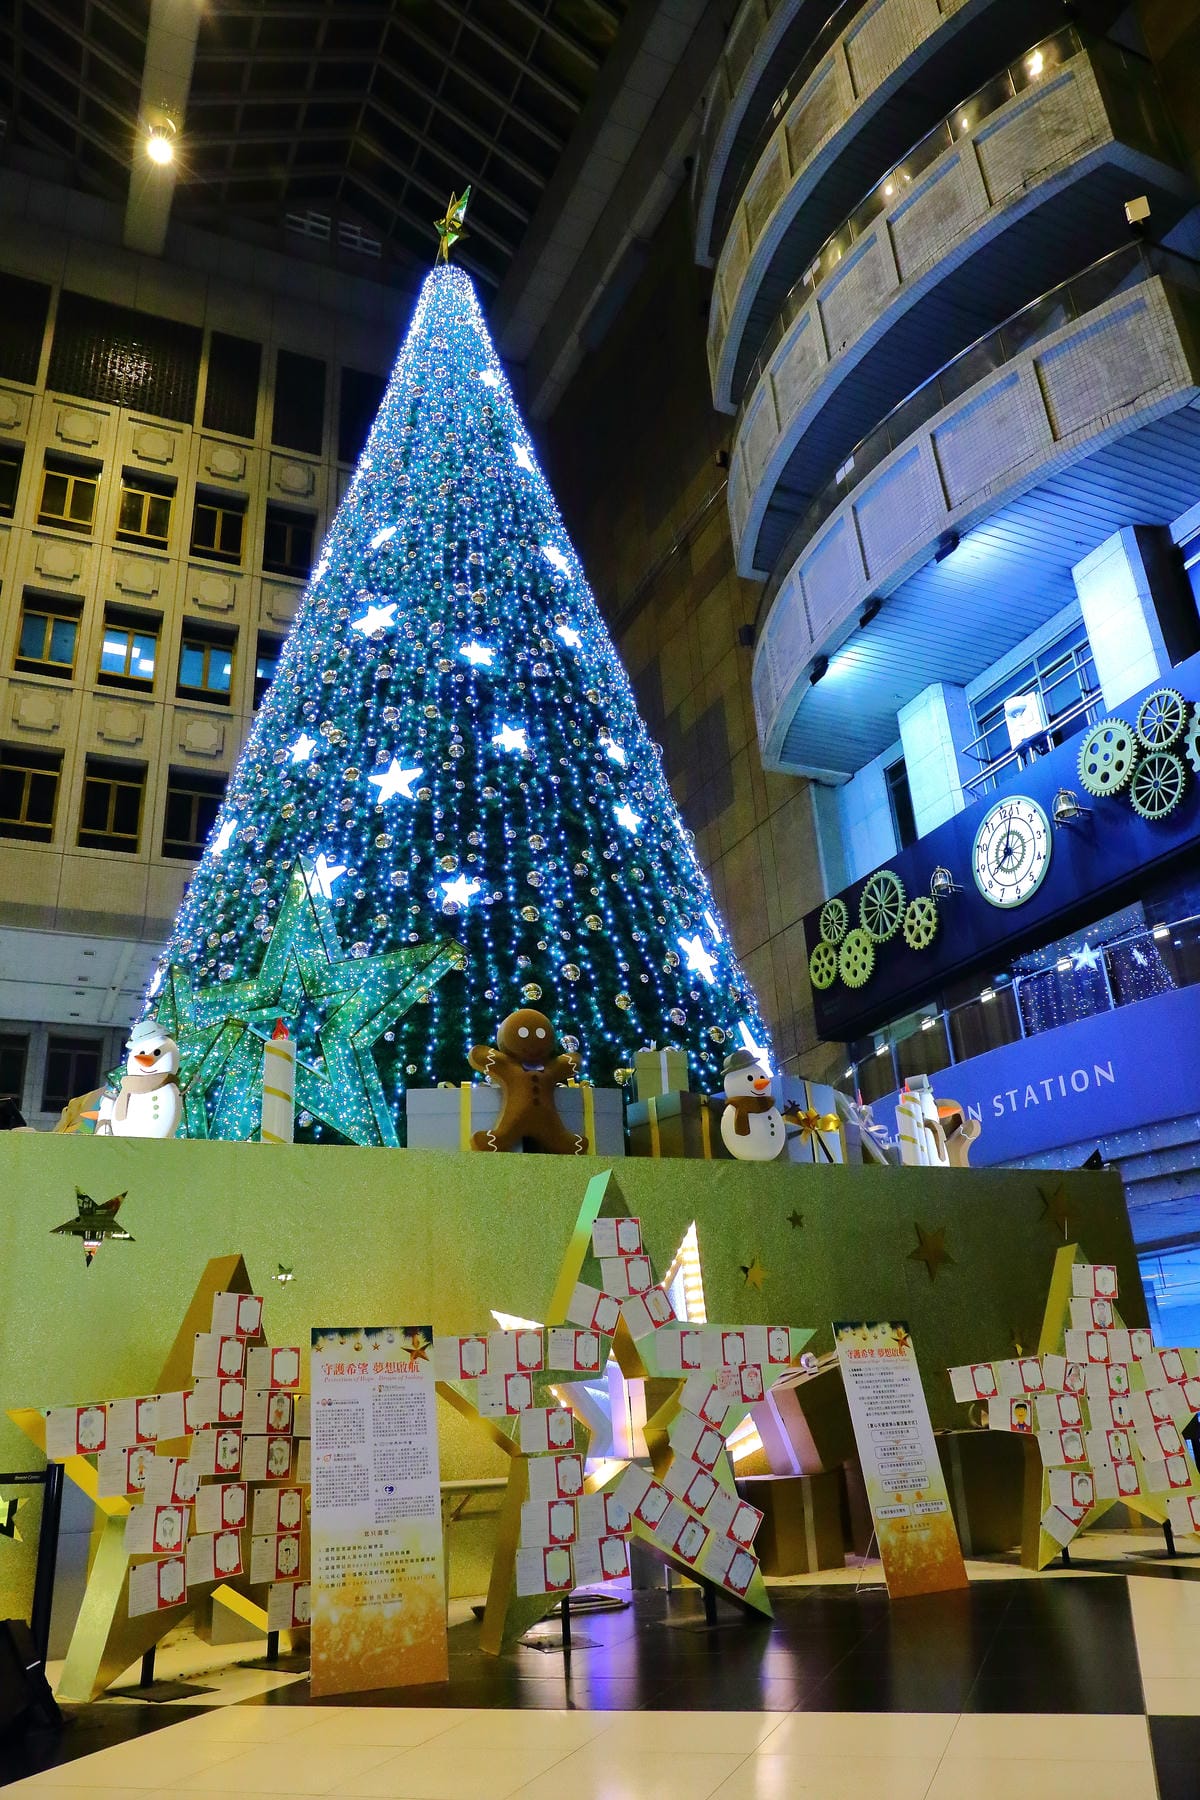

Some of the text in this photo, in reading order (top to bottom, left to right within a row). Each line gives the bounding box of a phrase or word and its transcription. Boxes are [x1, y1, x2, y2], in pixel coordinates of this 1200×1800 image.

[999, 809, 1007, 820] 12
[1028, 813, 1034, 822] 2
[1036, 830, 1042, 839] 3
[980, 844, 988, 853] 10
[1036, 851, 1042, 860] 4
[980, 864, 986, 872] 9
[1029, 871, 1035, 881] 5
[988, 880, 993, 889] 8
[1000, 887, 1005, 897] 7
[1016, 885, 1021, 895] 6
[992, 1060, 1116, 1117] STATION
[321, 1361, 369, 1376] 守護希望
